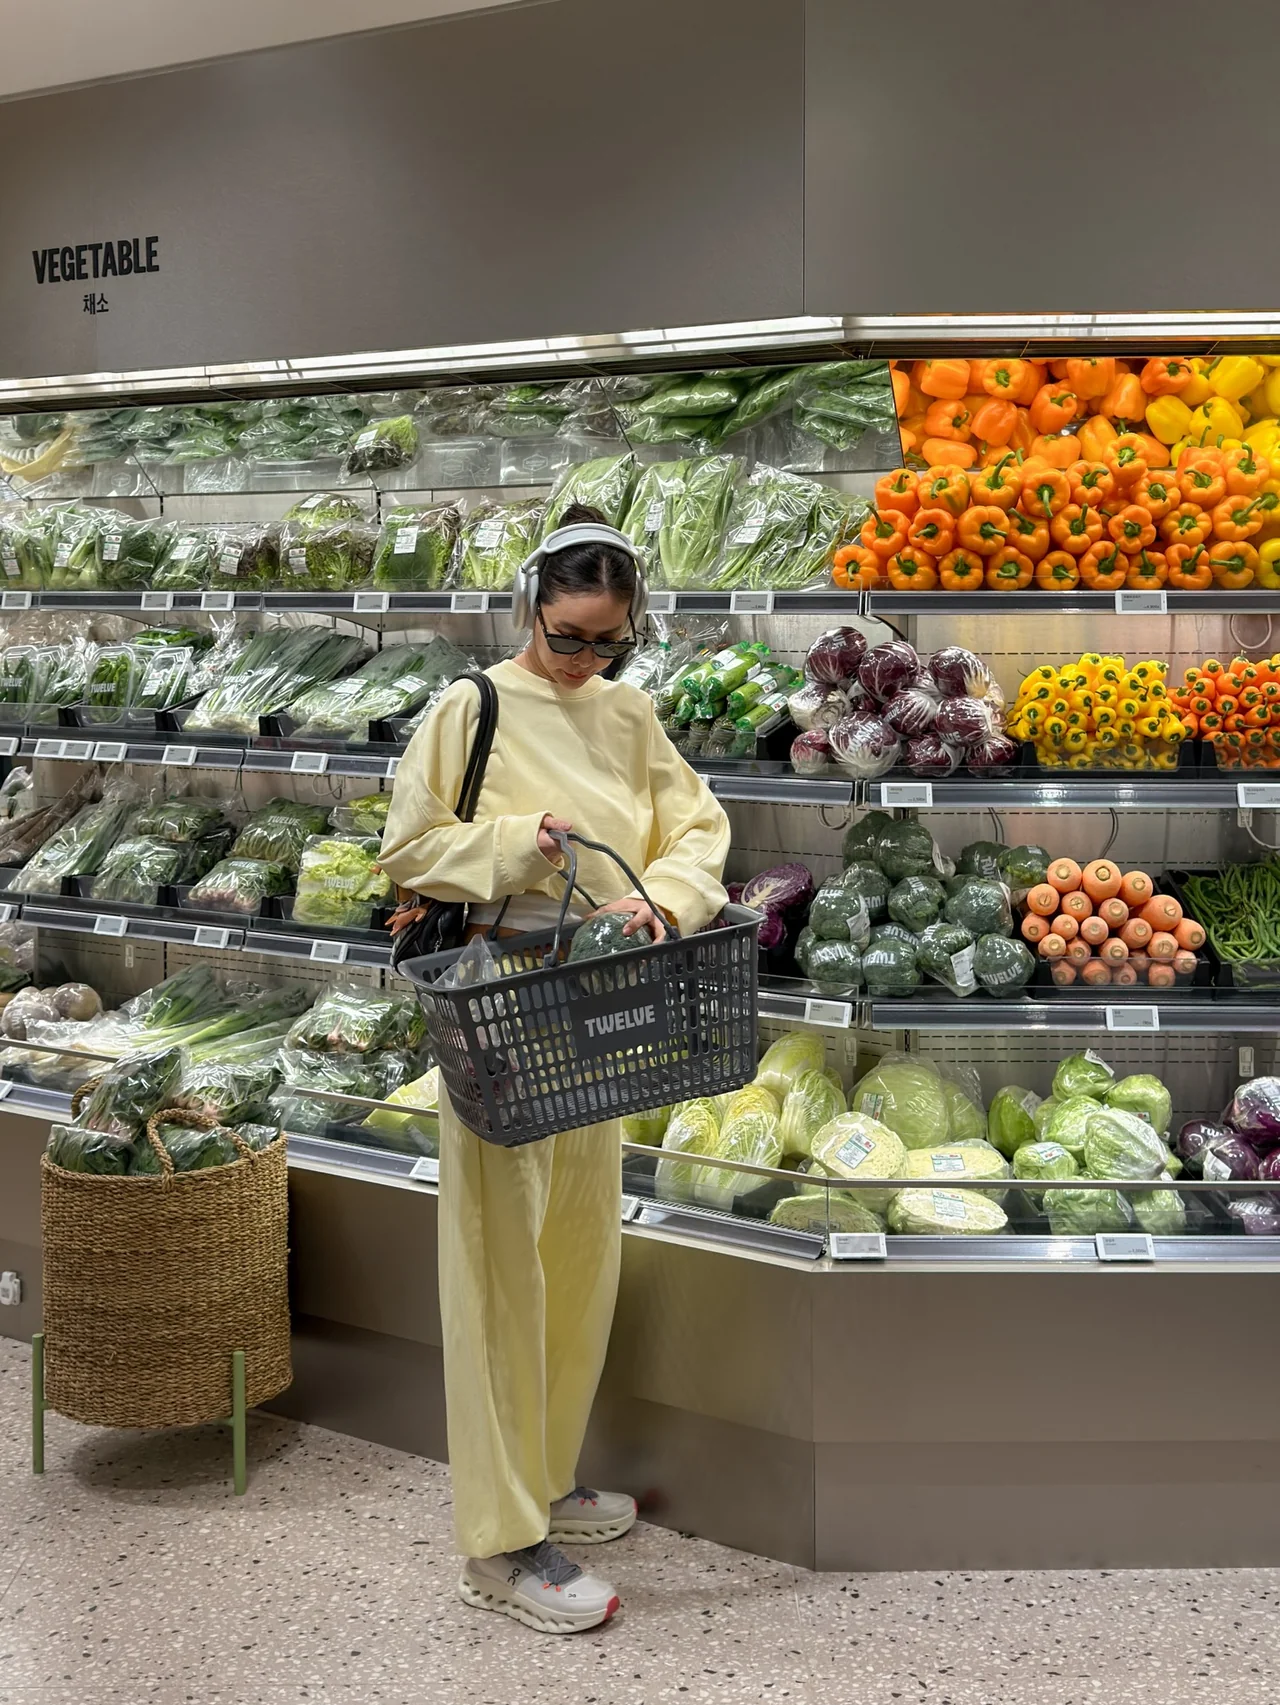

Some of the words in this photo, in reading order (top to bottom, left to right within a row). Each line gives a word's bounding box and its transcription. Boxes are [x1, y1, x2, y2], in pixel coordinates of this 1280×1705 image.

[32, 236, 160, 284] VEGETABLE
[82, 292, 109, 316] 채소
[90, 683, 117, 693] TWELVE
[267, 815, 301, 827] TWELVE
[323, 877, 356, 889] TWELVE
[980, 962, 1023, 986] TWELVE
[584, 1004, 656, 1038] TWELVE
[1226, 1201, 1275, 1215] TWELVE
